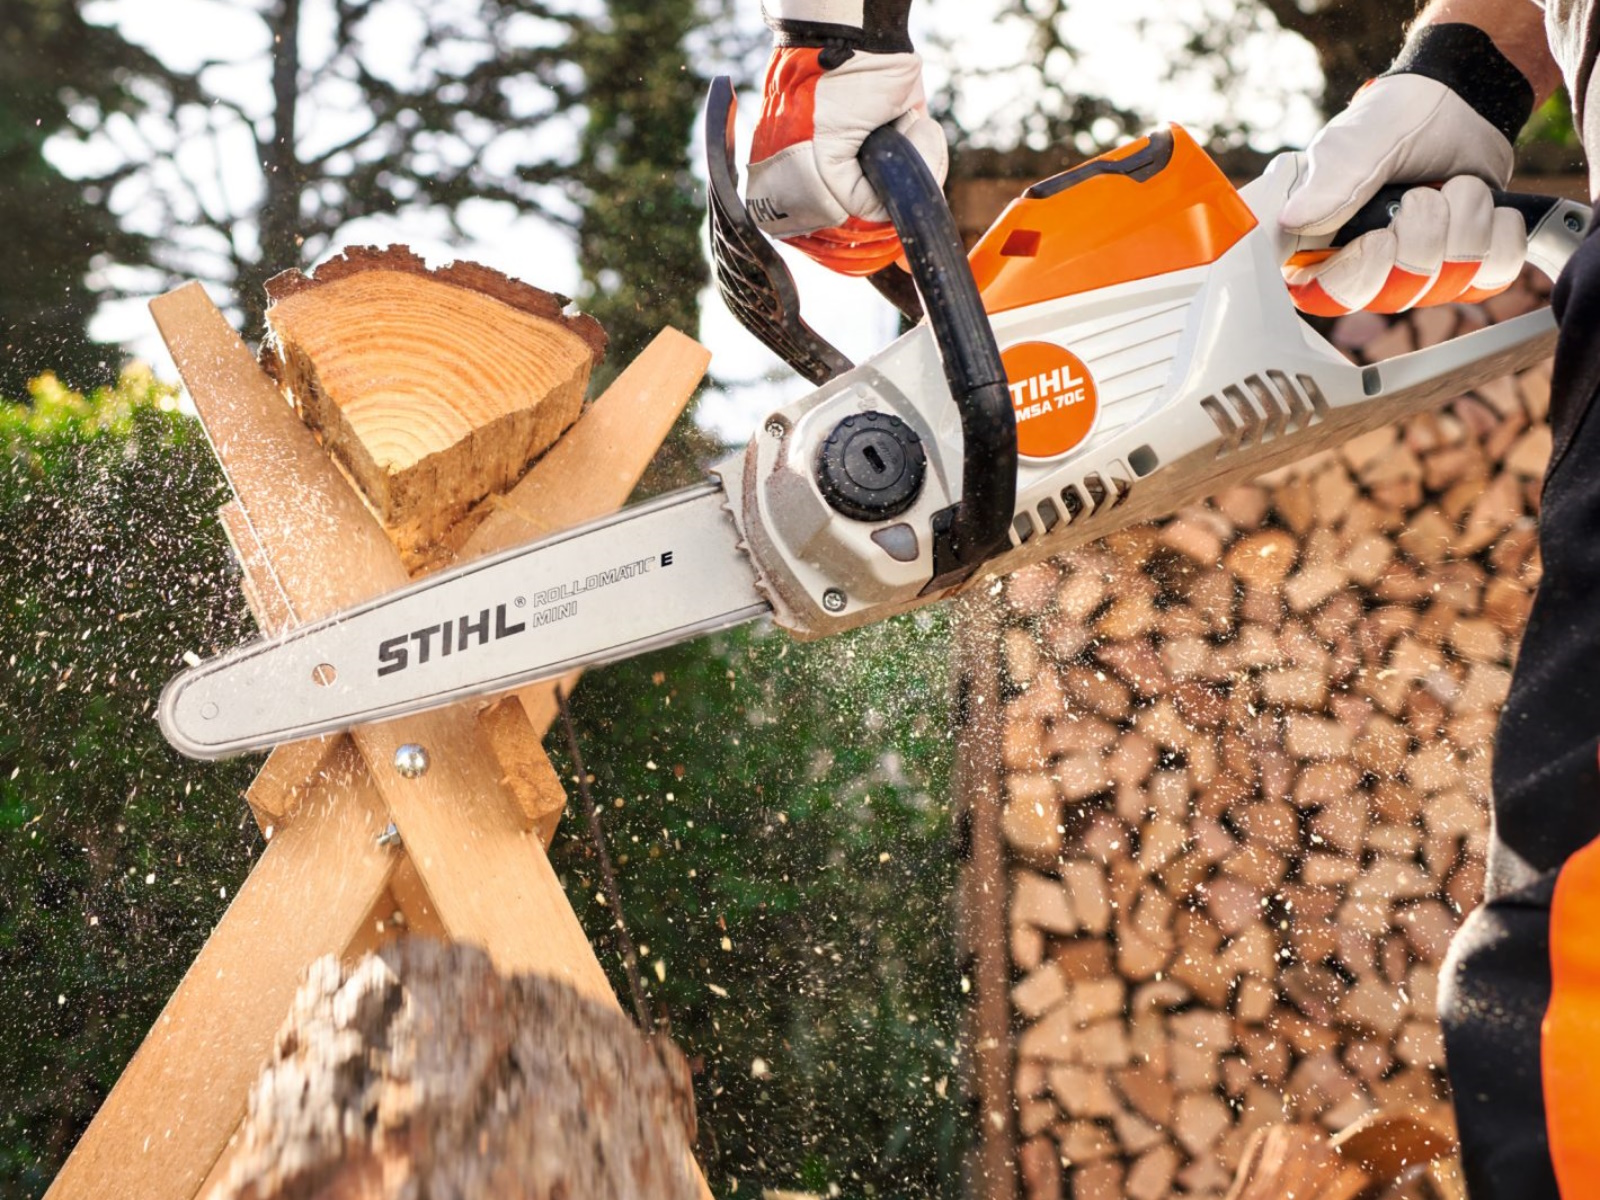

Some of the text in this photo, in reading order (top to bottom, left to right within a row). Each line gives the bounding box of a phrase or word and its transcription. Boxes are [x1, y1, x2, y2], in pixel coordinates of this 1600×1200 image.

[1008, 365, 1084, 407] TIHL
[1015, 388, 1085, 424] MSA 70C
[661, 551, 673, 567] E
[533, 601, 578, 628] MINI
